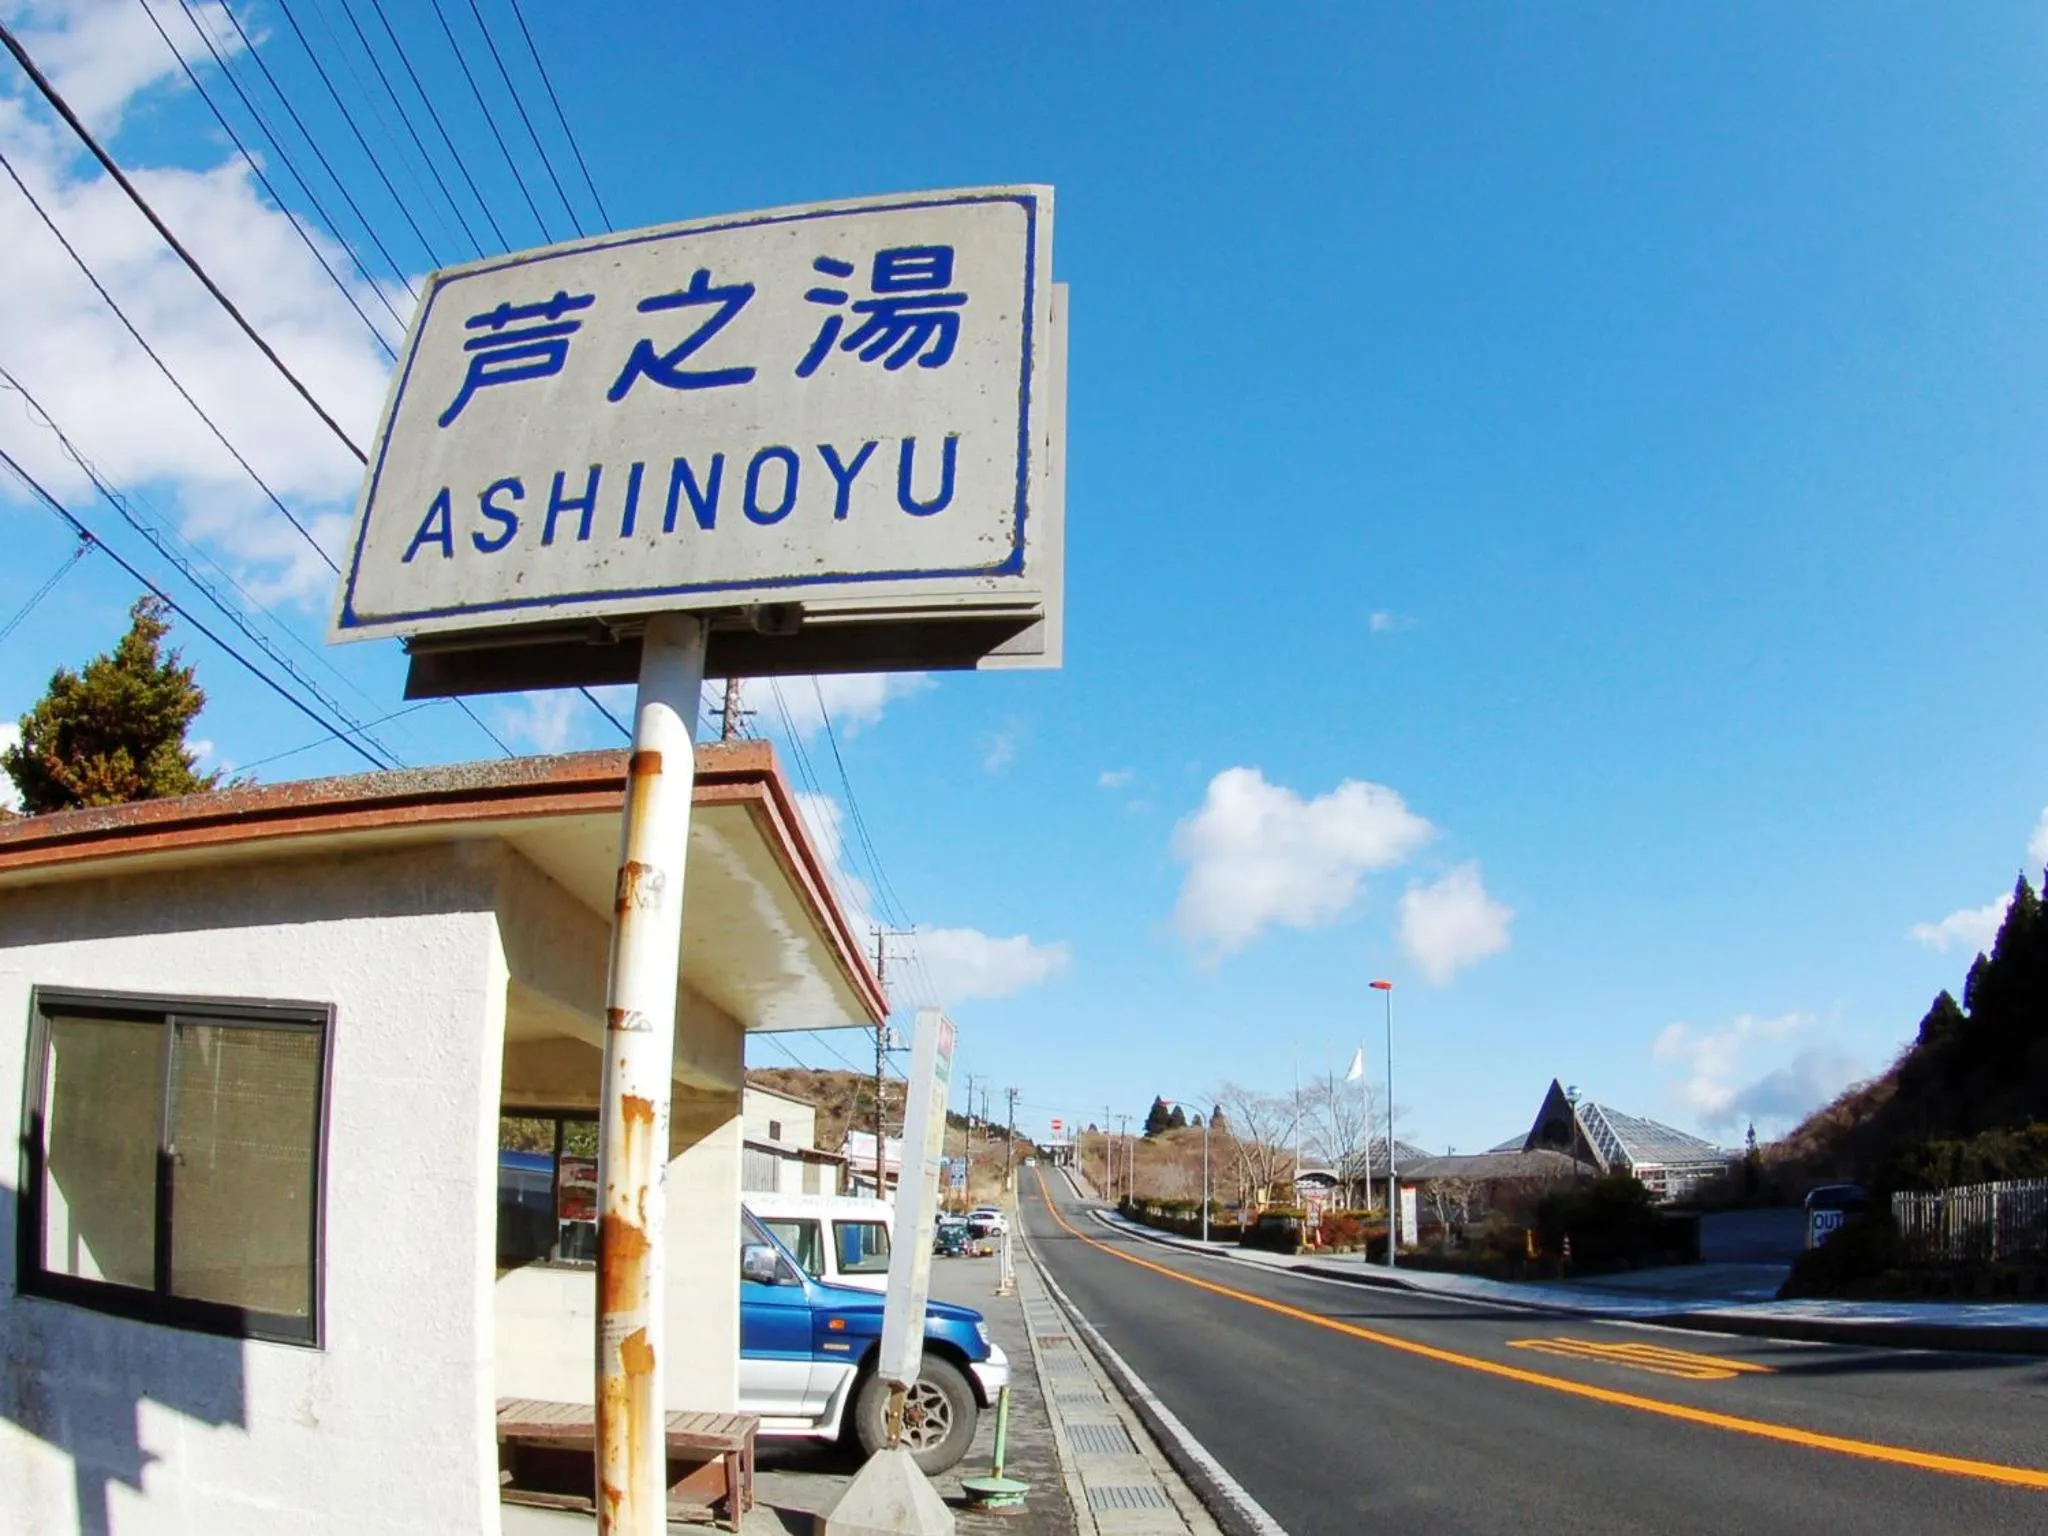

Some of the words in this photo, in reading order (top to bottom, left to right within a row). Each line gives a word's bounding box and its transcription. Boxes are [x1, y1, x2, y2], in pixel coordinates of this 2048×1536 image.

[439, 245, 967, 427] 芦之湯
[402, 434, 958, 562] ASHINOYU
[1814, 1213, 1845, 1230] OUT
